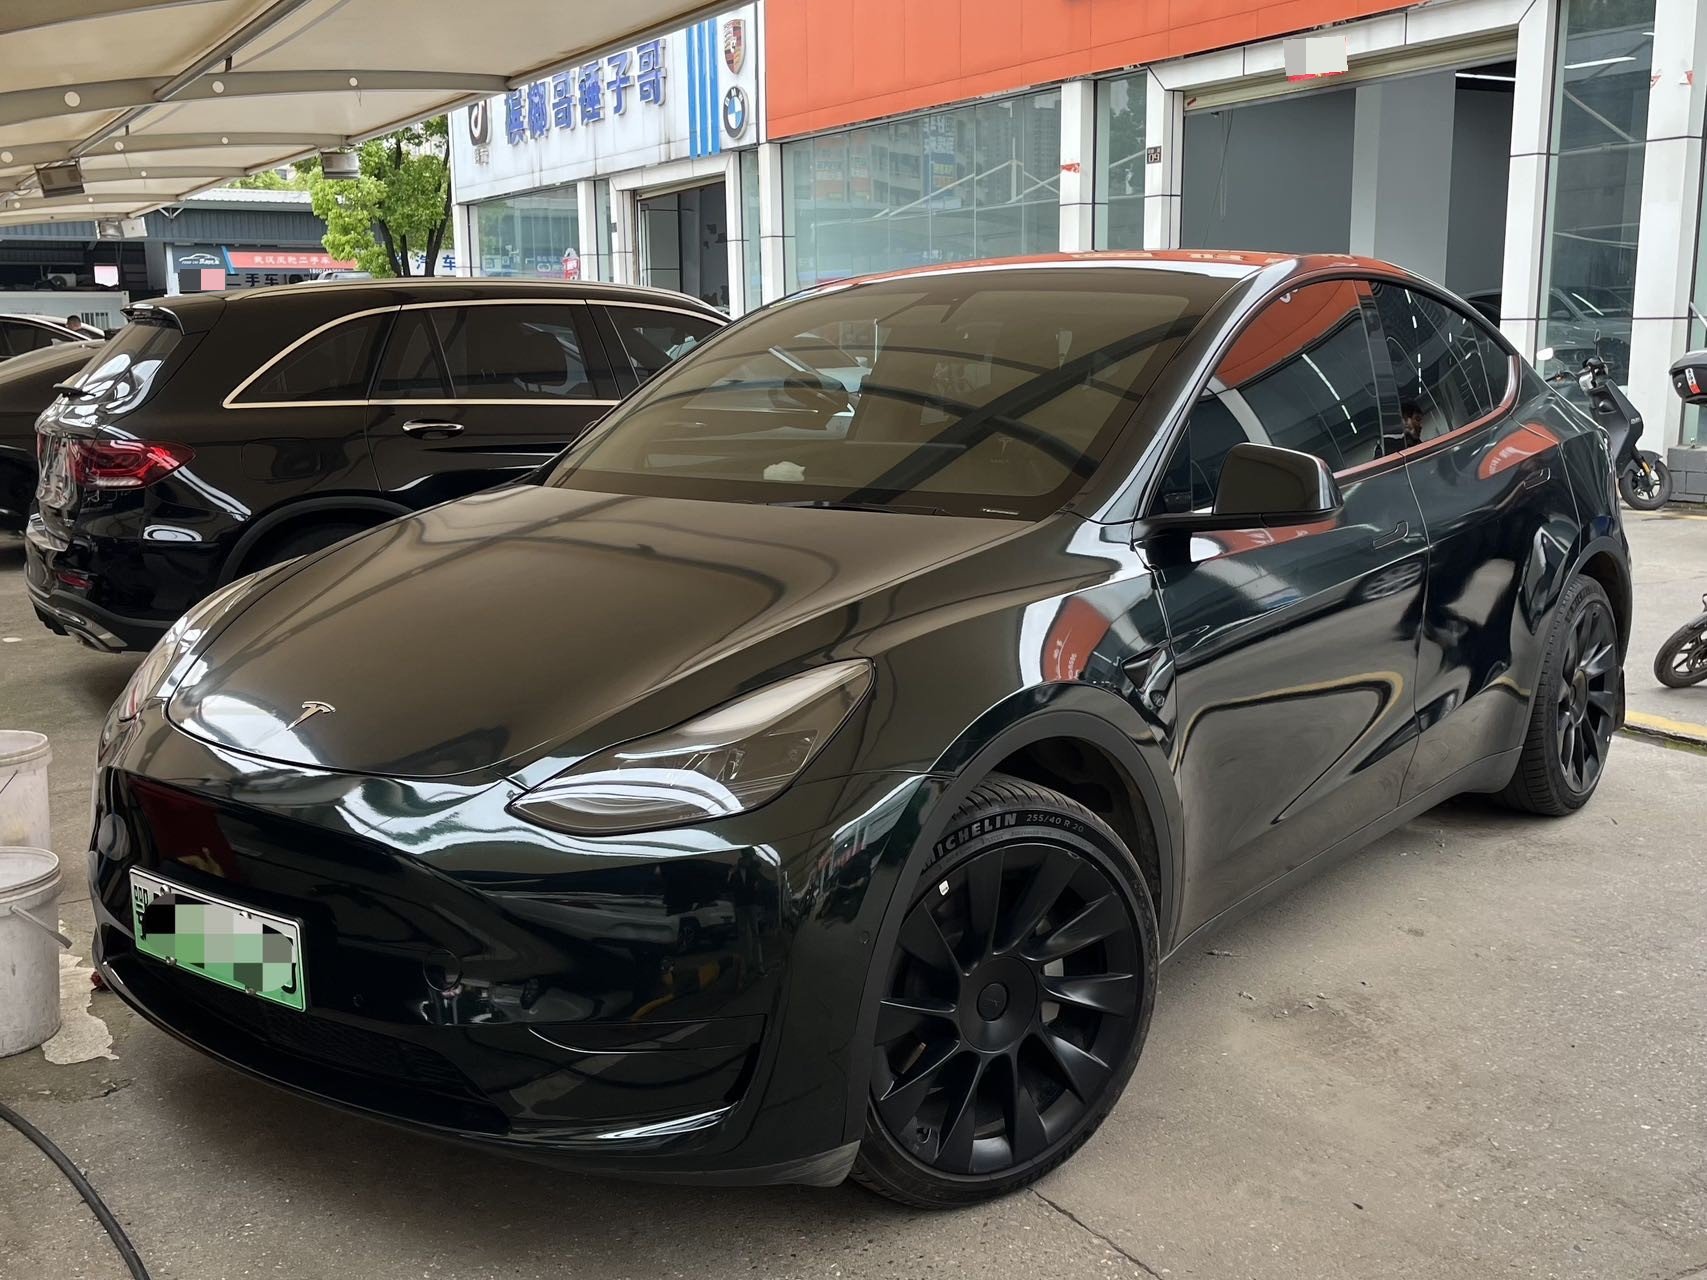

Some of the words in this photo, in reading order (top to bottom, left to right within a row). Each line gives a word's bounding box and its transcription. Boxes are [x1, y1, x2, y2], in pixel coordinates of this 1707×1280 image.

[1026, 813, 1062, 826] 255/40
[1063, 819, 1071, 827] R
[1072, 822, 1085, 833] 20
